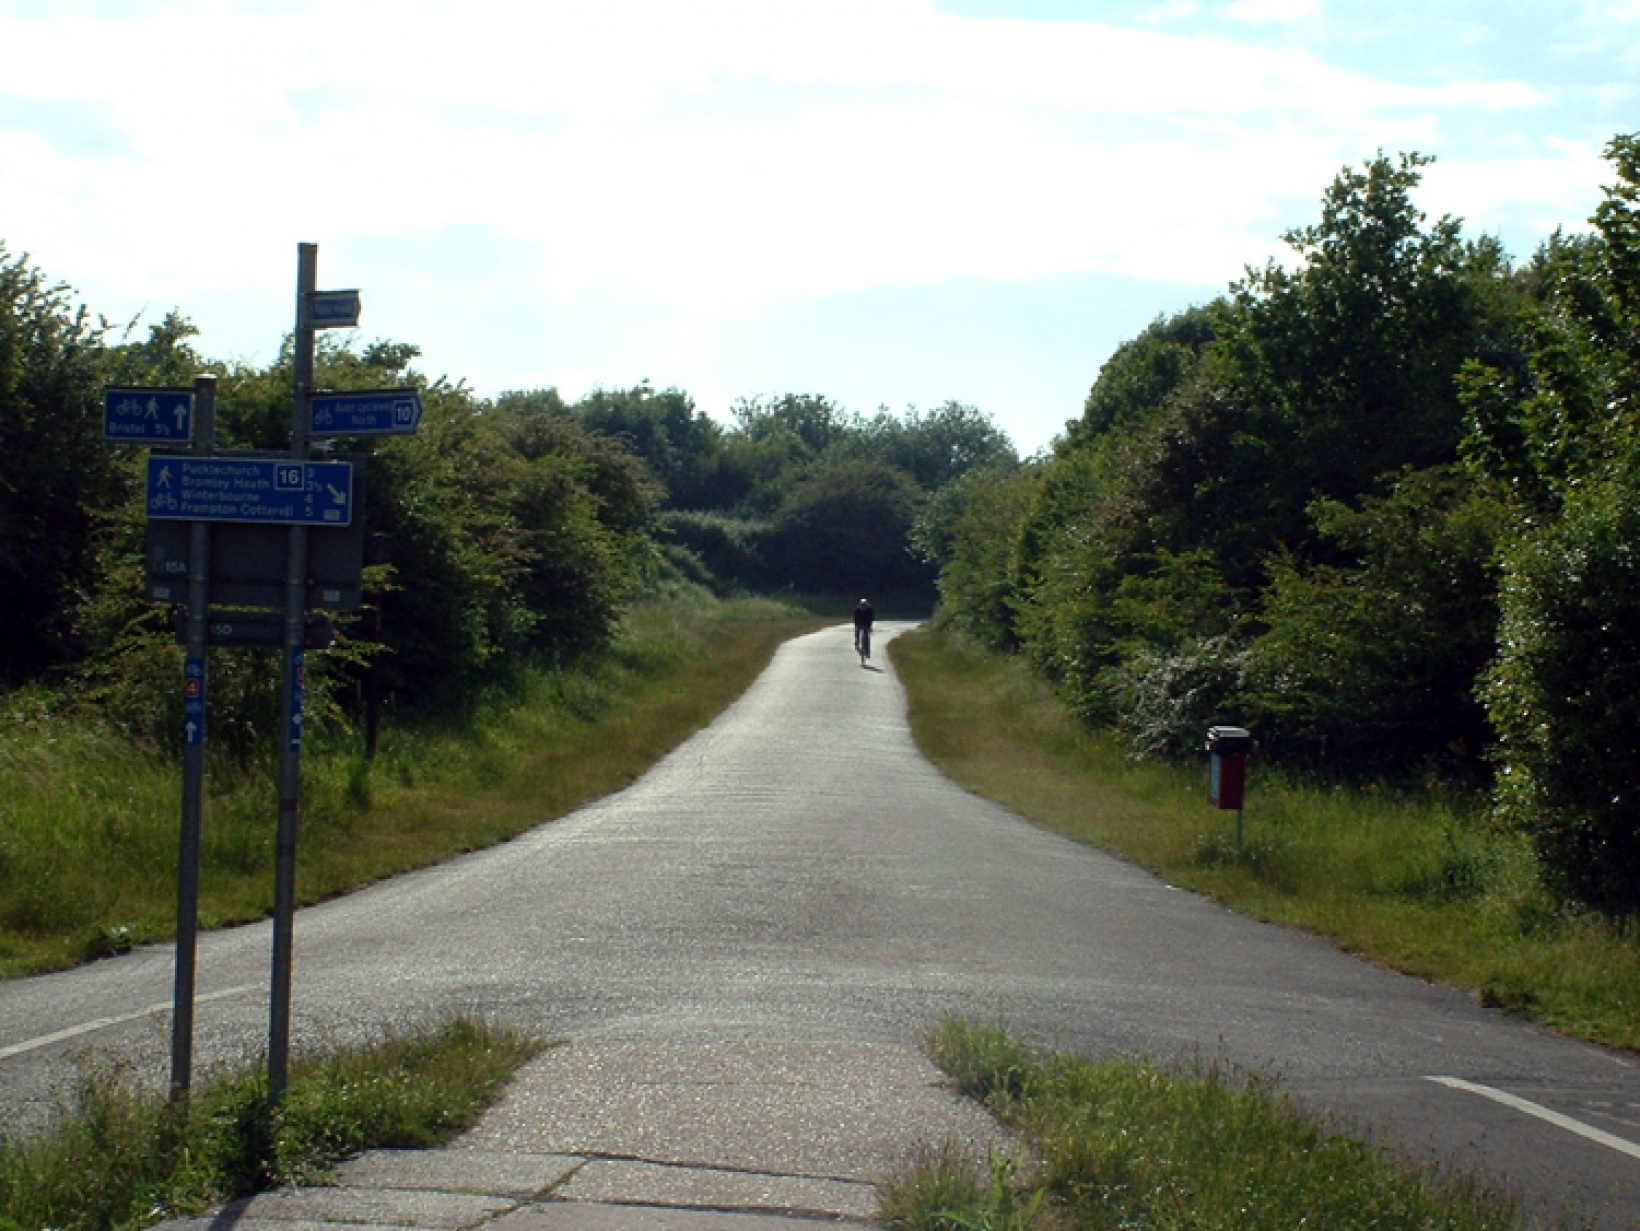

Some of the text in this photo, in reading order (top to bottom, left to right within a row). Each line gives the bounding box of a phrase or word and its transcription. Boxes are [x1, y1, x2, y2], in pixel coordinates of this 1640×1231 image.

[108, 421, 145, 434] Bristol
[181, 463, 261, 476] Pucklechurch
[279, 469, 300, 484] 16
[181, 476, 231, 490] Bromley
[233, 478, 270, 491] Heath
[181, 489, 261, 502] Winterbourne
[181, 500, 237, 515] Frampton
[240, 502, 294, 517] Cotterell
